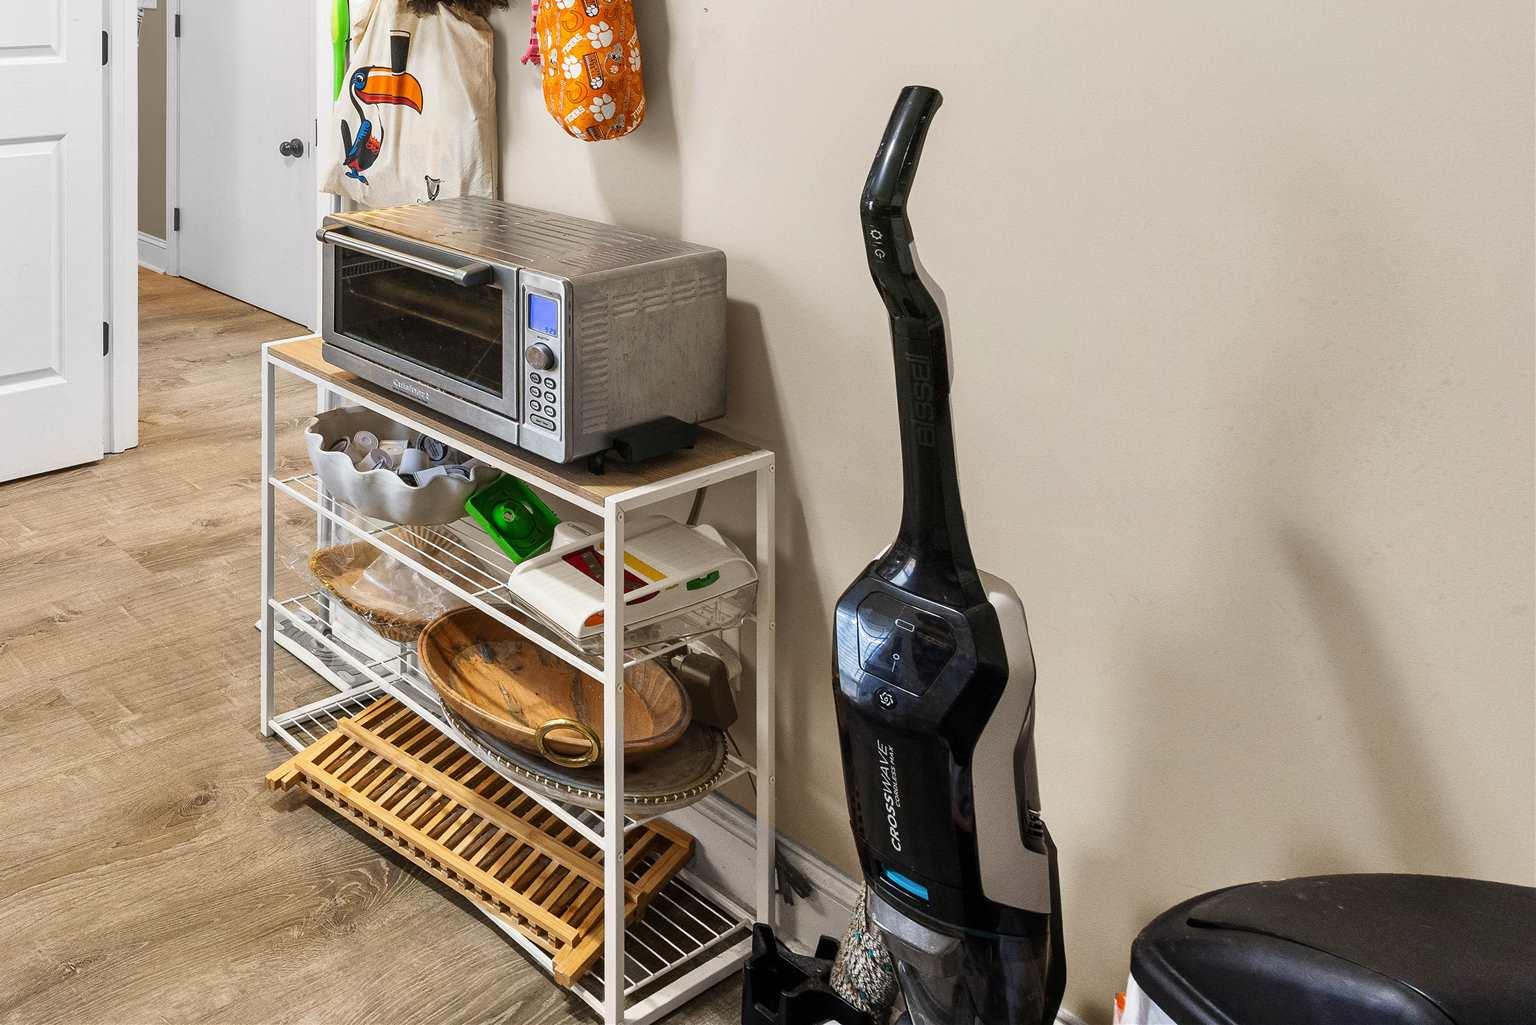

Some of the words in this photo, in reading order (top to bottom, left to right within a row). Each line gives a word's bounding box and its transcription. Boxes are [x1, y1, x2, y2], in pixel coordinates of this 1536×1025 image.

[888, 744, 896, 765] MAX
[876, 739, 901, 852] CROSSWAVE
[890, 766, 901, 808] CORDLESS
